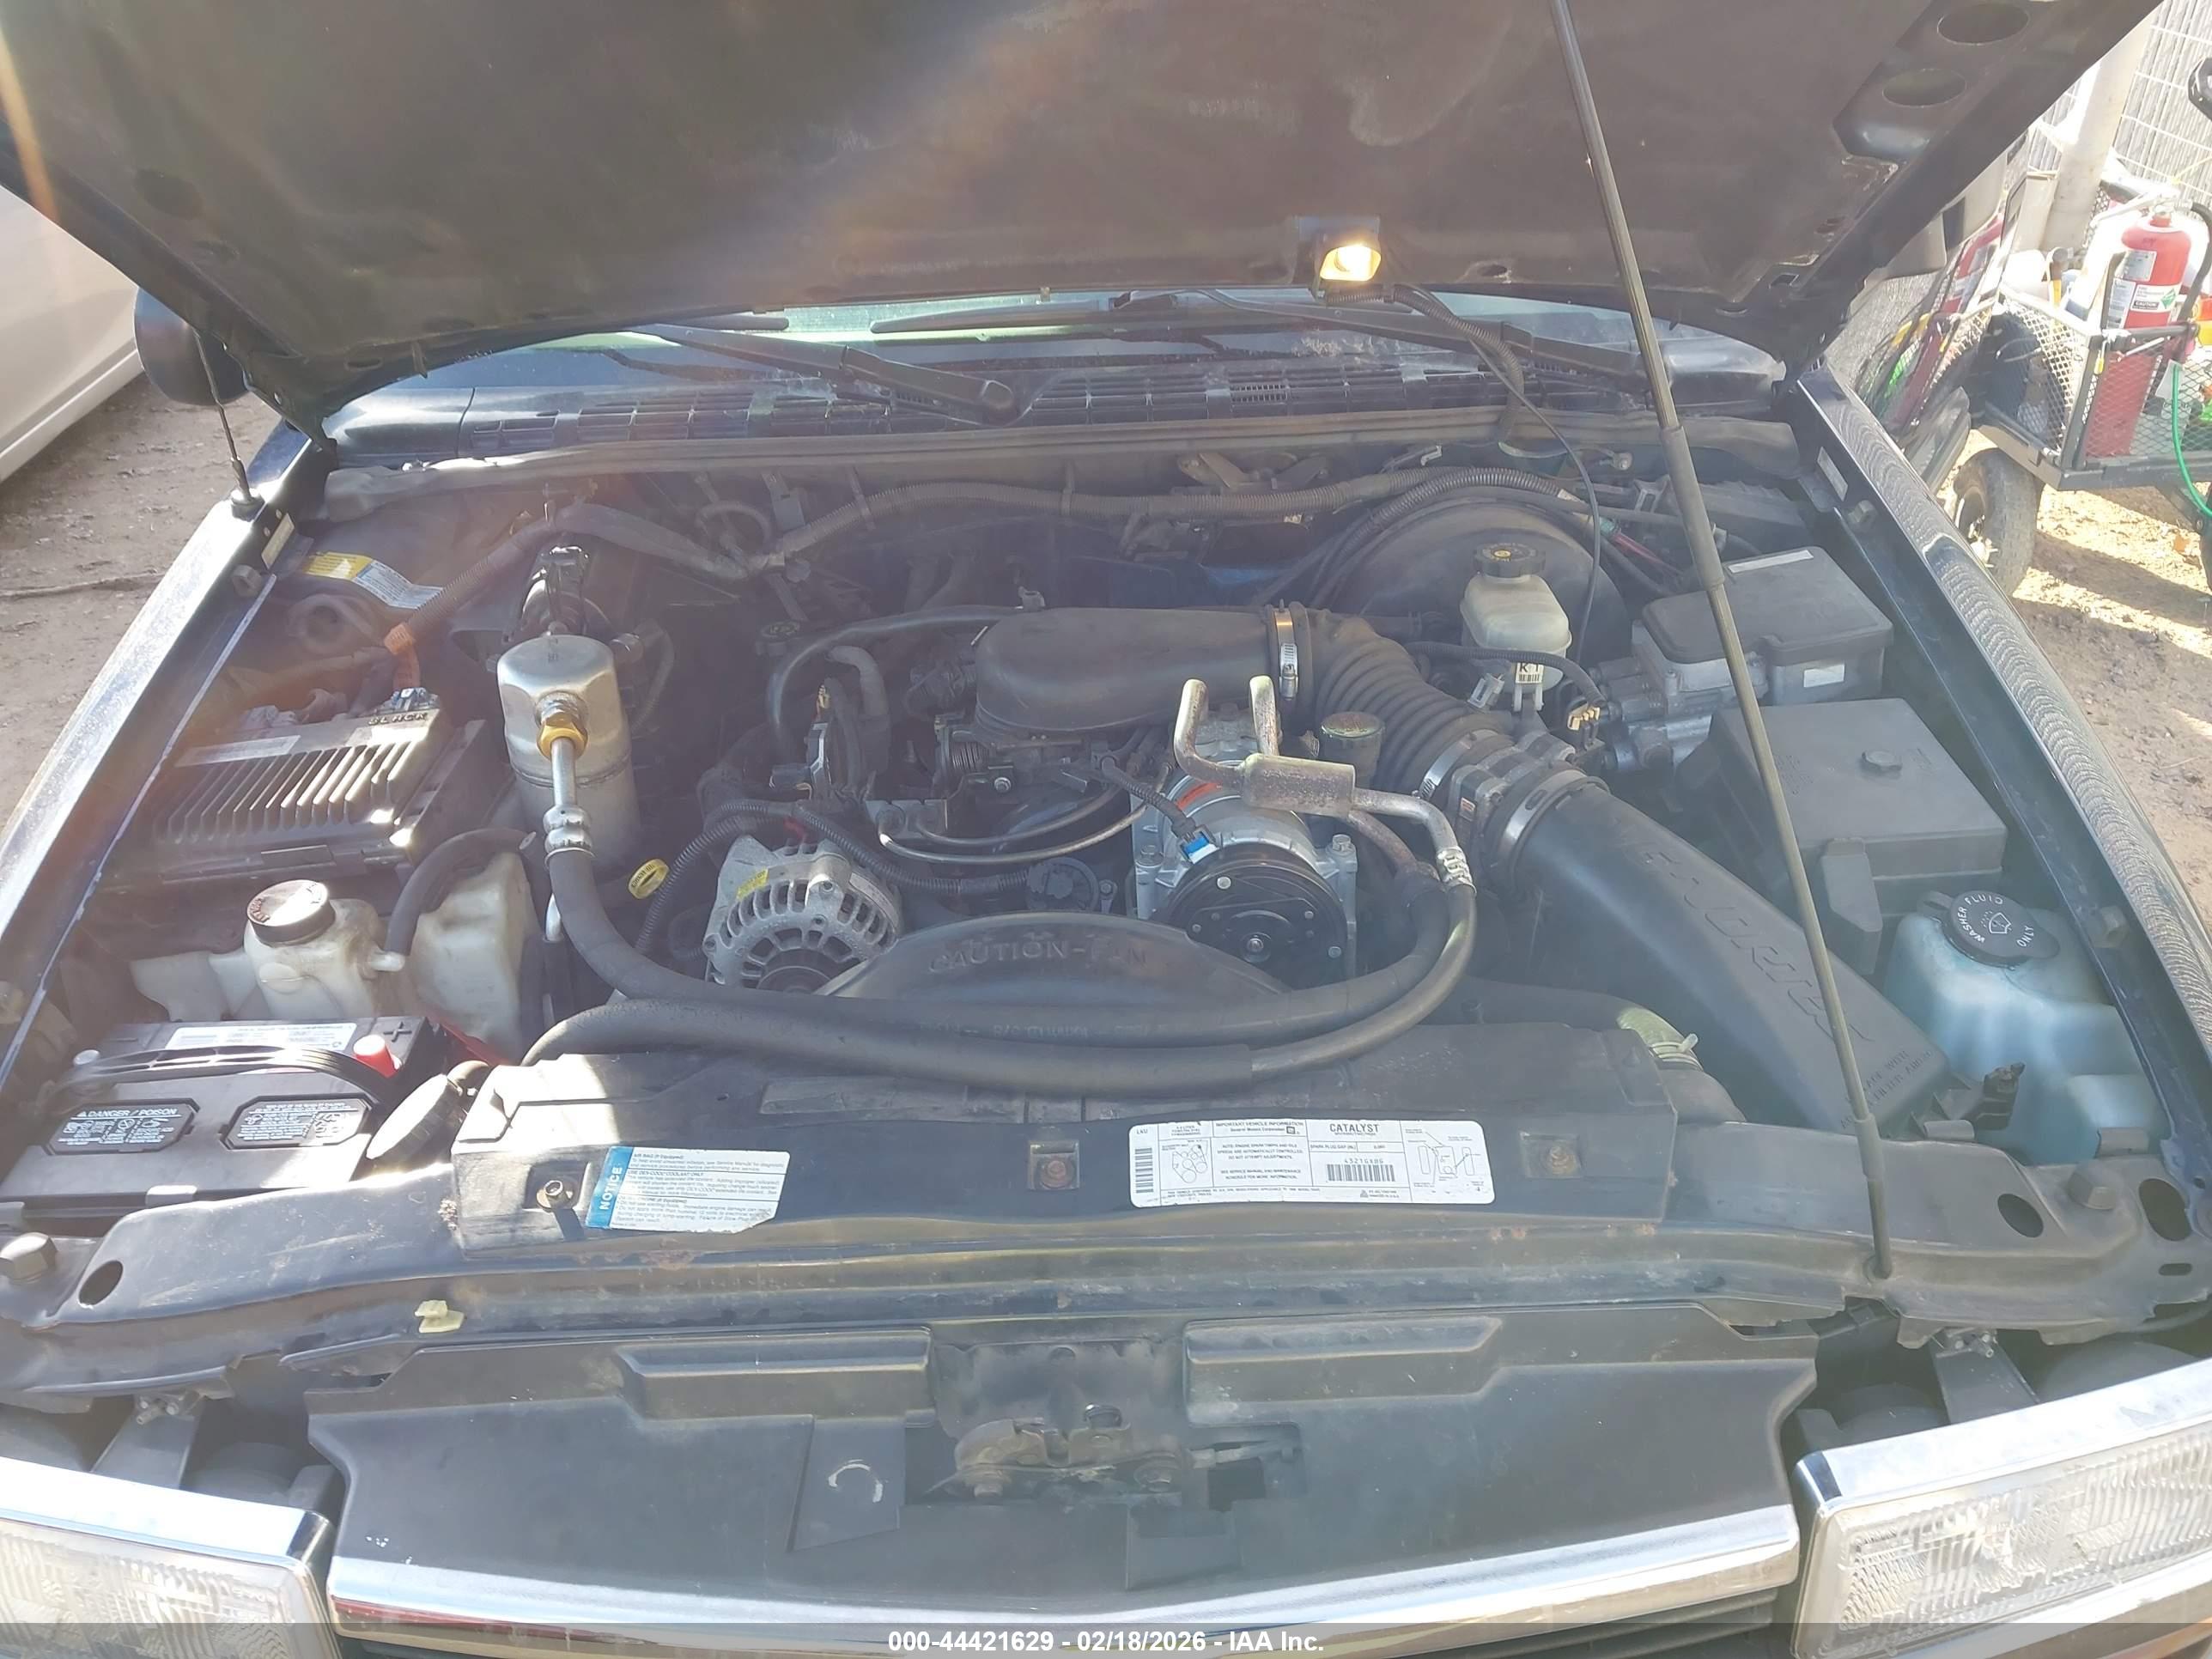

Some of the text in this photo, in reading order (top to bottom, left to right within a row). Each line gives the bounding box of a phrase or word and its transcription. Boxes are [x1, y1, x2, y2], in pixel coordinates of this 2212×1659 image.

[1958, 894, 2003, 943] WASHER FLUID
[2016, 926, 2034, 947] ONLY
[139, 1108, 178, 1116] POISON
[1329, 1123, 1380, 1133] CATALYST
[599, 1167, 623, 1210] NOTICE
